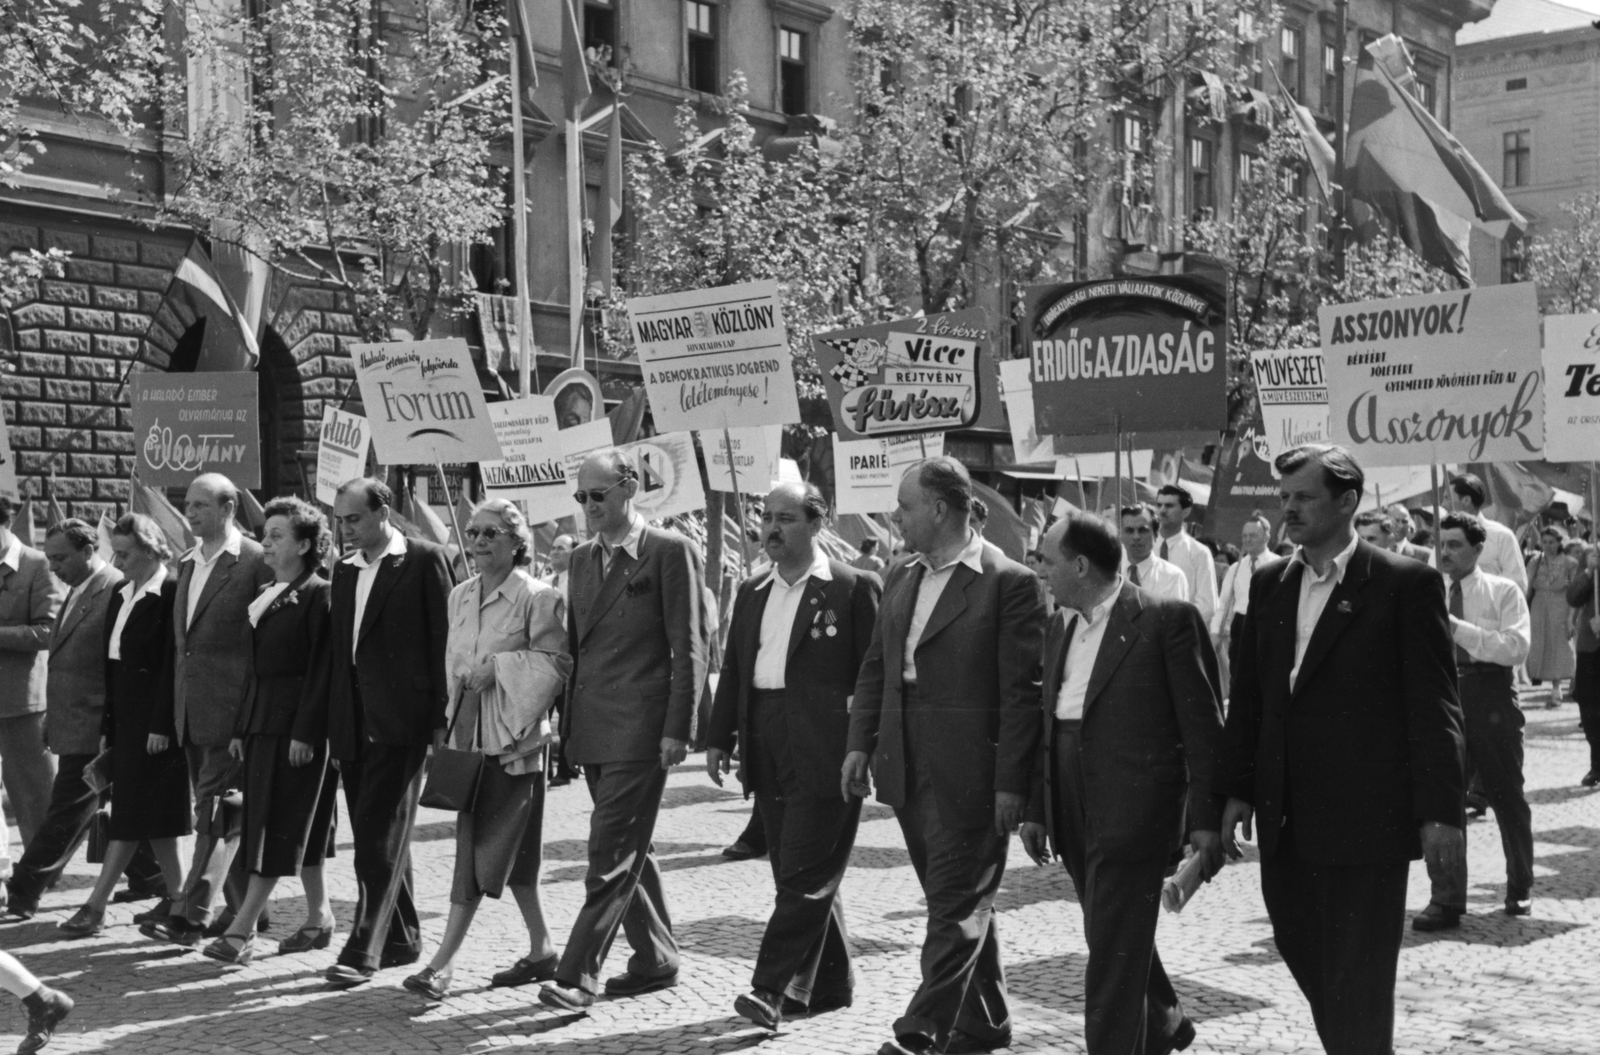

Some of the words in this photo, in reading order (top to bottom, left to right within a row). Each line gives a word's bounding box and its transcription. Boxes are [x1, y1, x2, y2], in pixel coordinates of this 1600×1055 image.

[1088, 283, 1116, 299] NEMZETI
[1118, 280, 1164, 299] VÁLLALATOK
[636, 315, 694, 343] MAGYAR
[711, 304, 775, 335] KÖZLÖNY
[916, 317, 928, 334] 2
[1330, 293, 1472, 345] ASSZONYOK!
[686, 341, 722, 352] HIVATALOS
[722, 339, 736, 349] LAP
[905, 338, 966, 365] Vicc
[1032, 320, 1215, 382] ERDŐGAZDASÁG
[650, 373, 658, 385] A
[659, 363, 735, 384] DEMOKRATIKUS
[736, 359, 780, 377] JOGREND
[896, 370, 963, 384] REJTVÉNY
[1254, 353, 1327, 386] MŰVÉSZET
[1505, 371, 1518, 384] AZ
[142, 389, 149, 401] A
[150, 385, 185, 401] HALADÓ
[187, 388, 218, 401] EMBER
[377, 381, 476, 422] Forum
[236, 409, 247, 421] AZ
[1346, 370, 1543, 461] Asszonyok
[850, 454, 880, 470] IPARI
